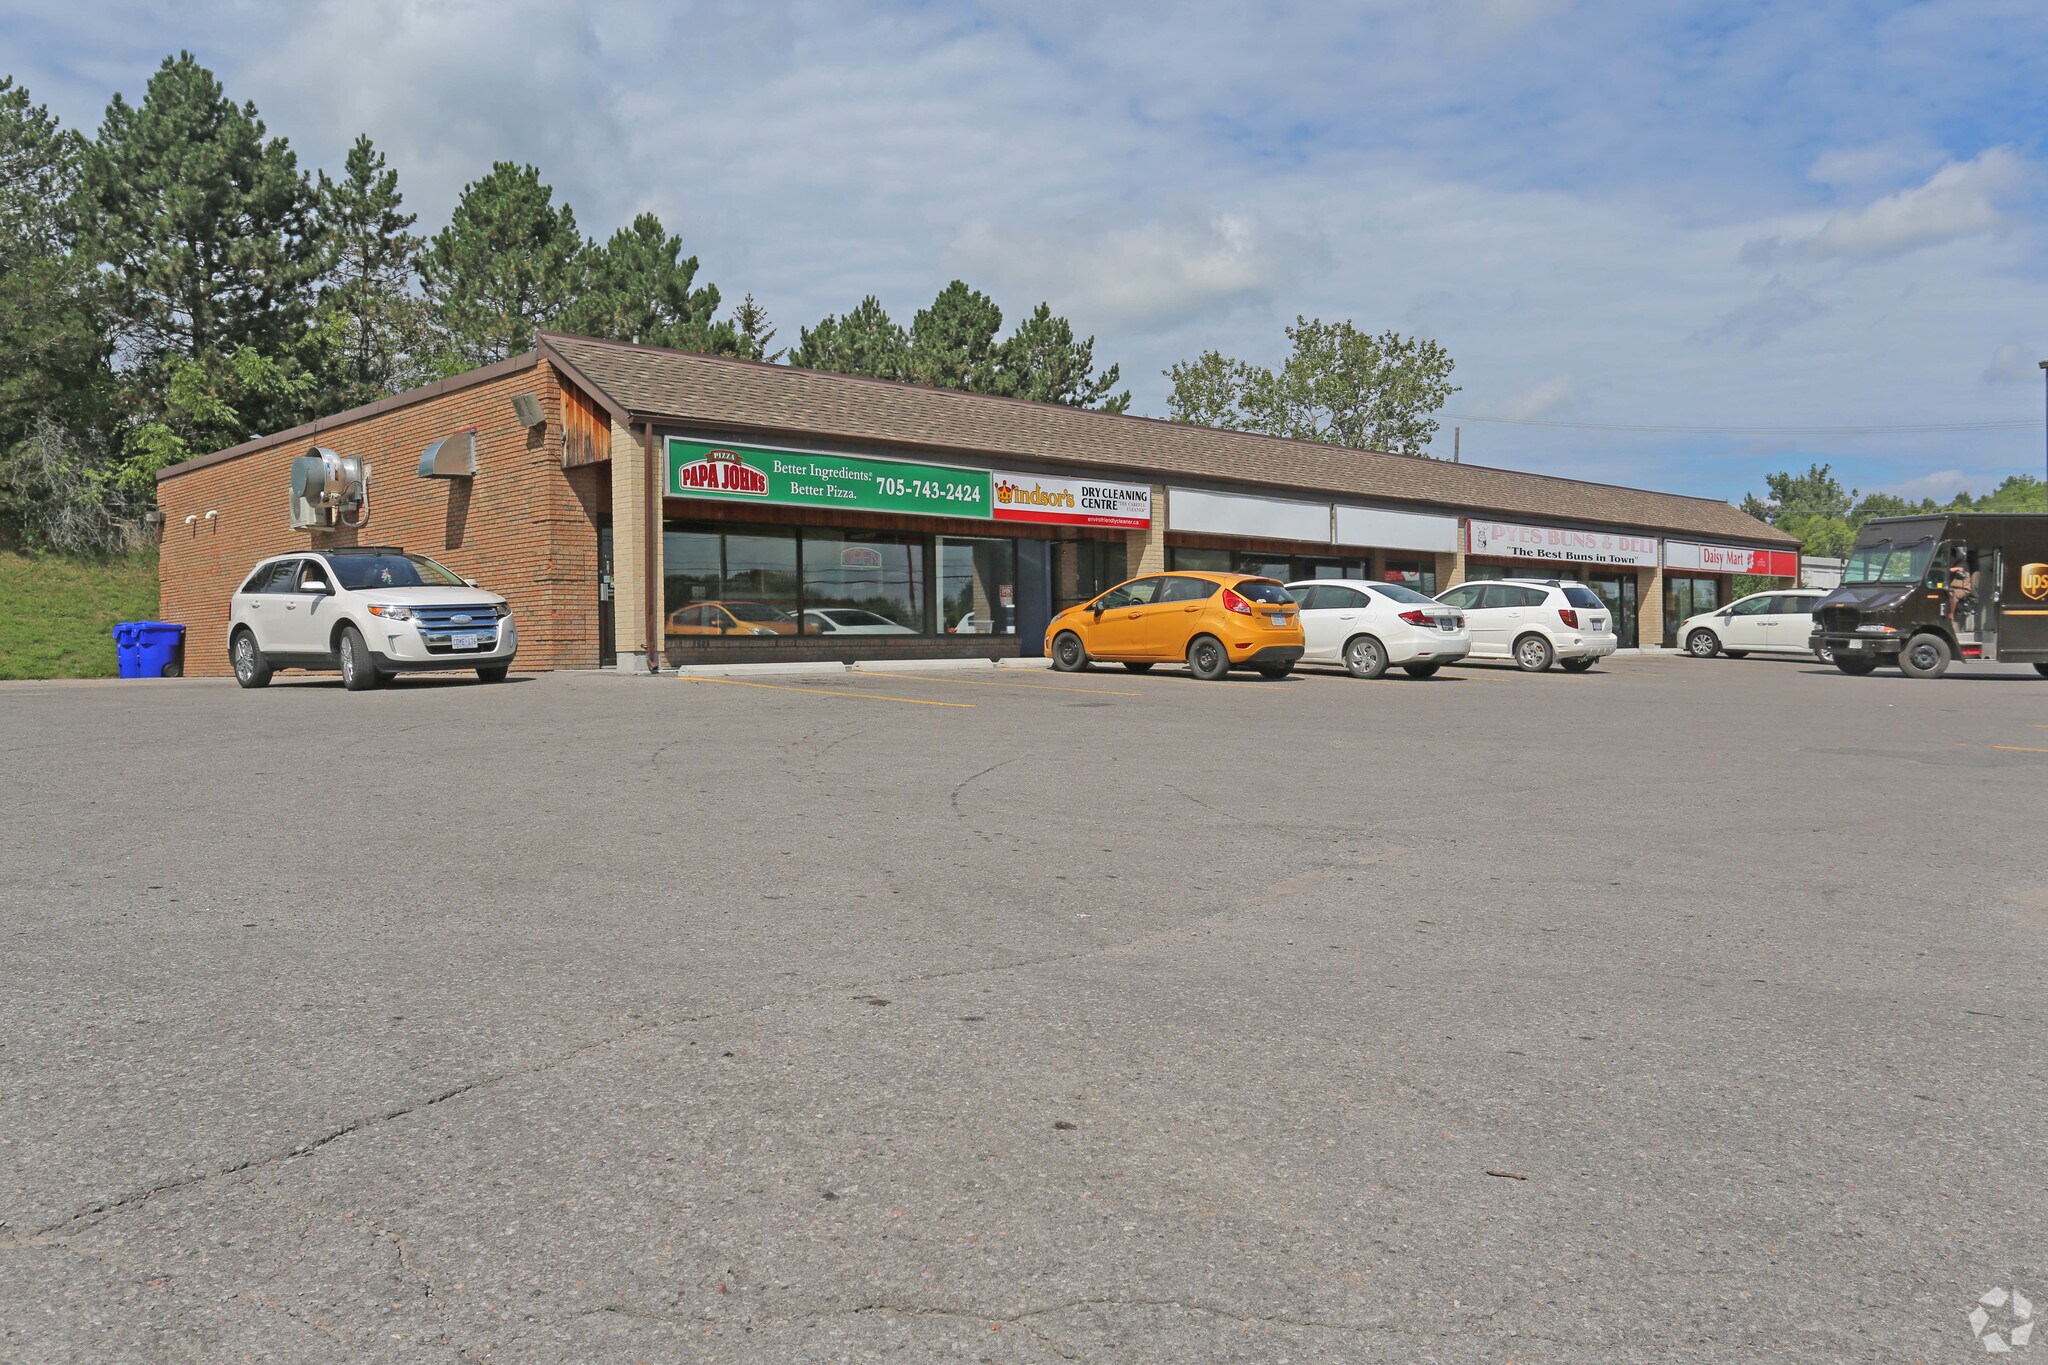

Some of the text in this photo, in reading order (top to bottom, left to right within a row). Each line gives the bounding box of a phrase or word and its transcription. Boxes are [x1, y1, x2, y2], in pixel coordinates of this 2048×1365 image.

[713, 452, 735, 460] PIZZA
[683, 464, 719, 488] PAPA
[773, 460, 807, 475] Better
[790, 481, 857, 499] Better Pizza.
[876, 477, 981, 503] 705-743-2424
[1081, 486, 1148, 502] DRY CLEANING
[1081, 497, 1118, 511] CENTRE
[1547, 529, 1597, 549] BUNS
[1601, 536, 1613, 551] &
[1618, 537, 1654, 554] DELI
[843, 550, 880, 566] OPEN
[1537, 549, 1562, 560] Best
[1566, 552, 1594, 562] Buns
[1596, 553, 1606, 562] in
[1703, 548, 1723, 565] Daisy
[1726, 550, 1744, 566] Mart
[2024, 574, 2048, 595] ups
